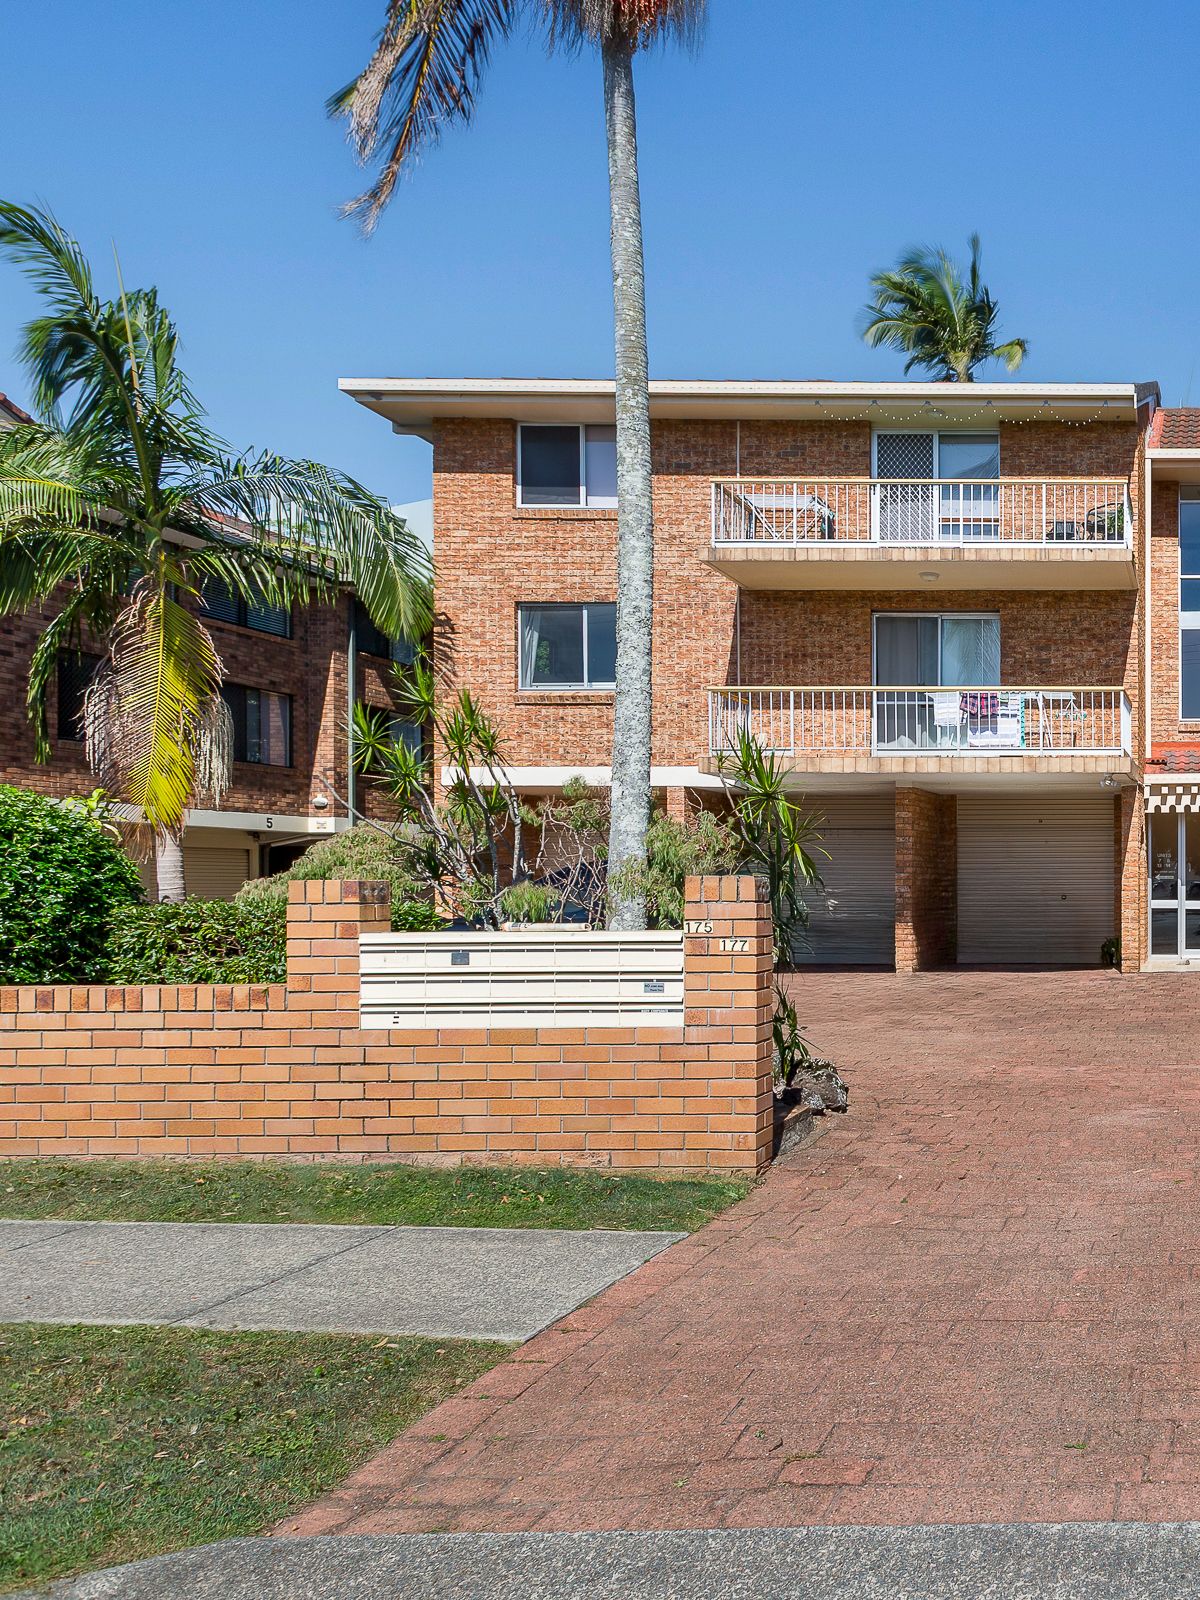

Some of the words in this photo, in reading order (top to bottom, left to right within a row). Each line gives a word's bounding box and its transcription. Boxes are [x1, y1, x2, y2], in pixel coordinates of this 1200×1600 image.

[266, 817, 274, 829] 5
[685, 921, 713, 934] 175
[721, 939, 748, 952] 177
